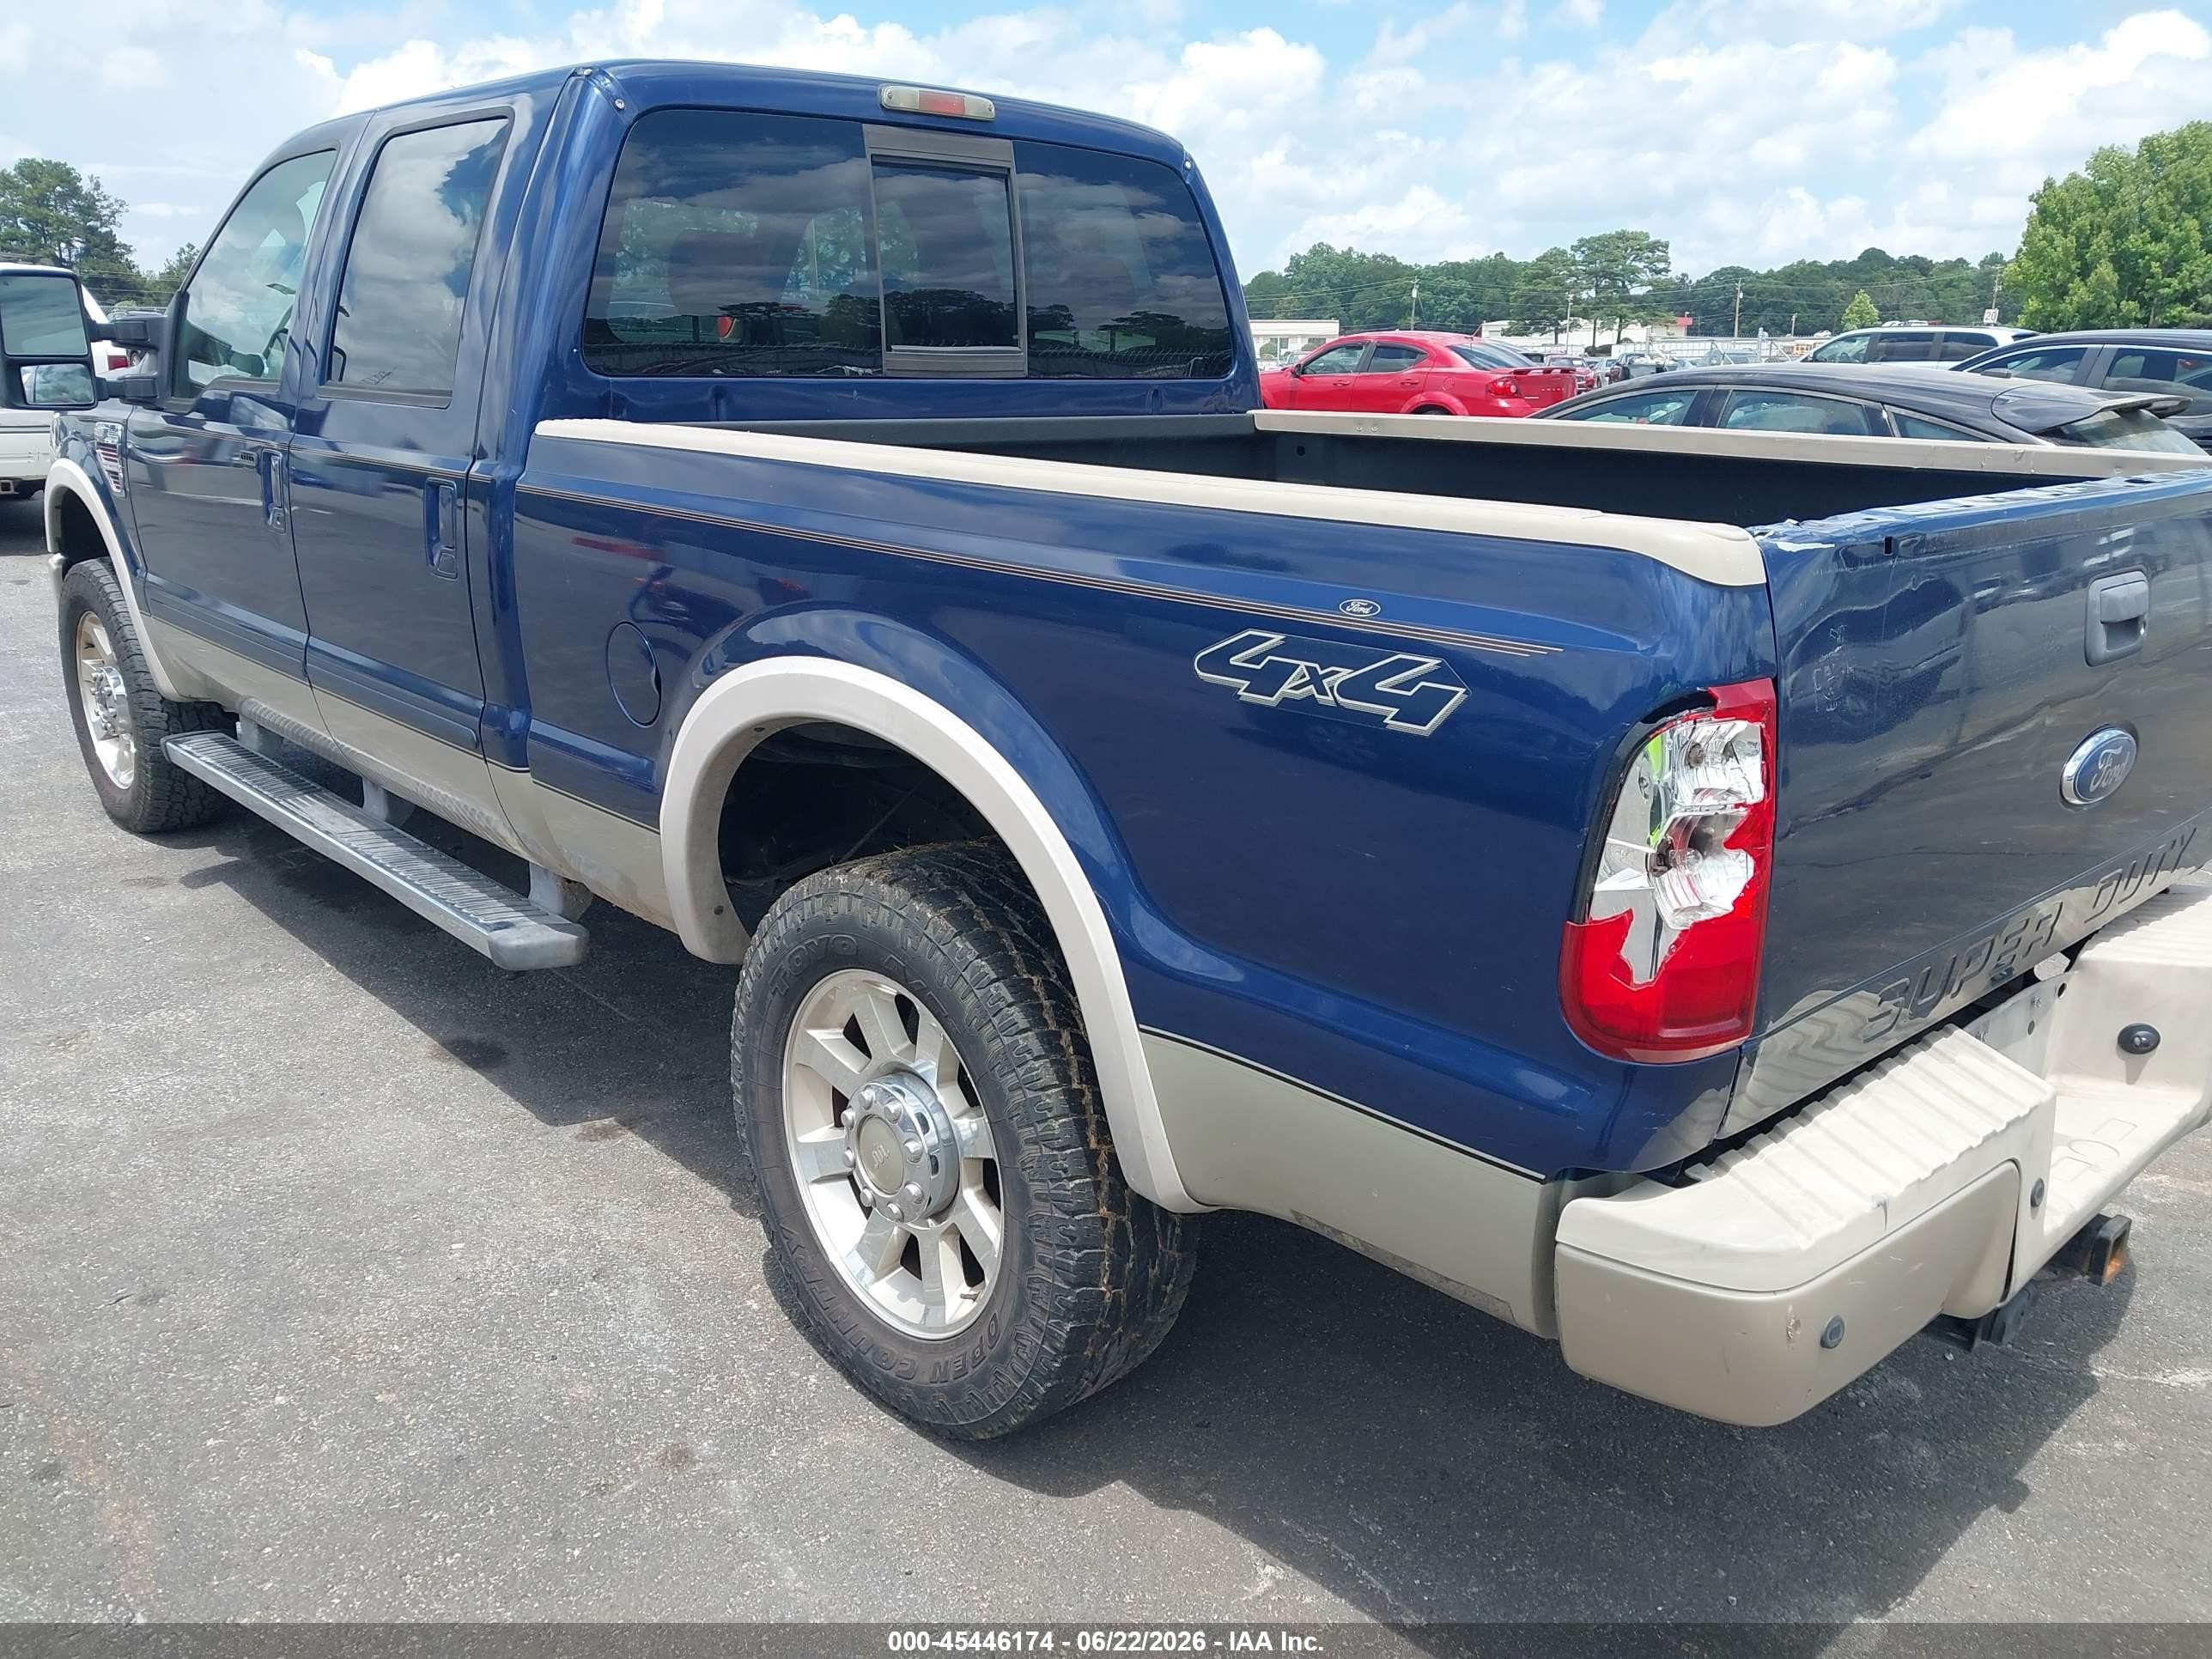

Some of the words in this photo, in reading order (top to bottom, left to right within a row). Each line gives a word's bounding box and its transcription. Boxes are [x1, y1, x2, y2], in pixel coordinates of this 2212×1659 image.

[1345, 601, 1374, 614] Ford
[769, 933, 860, 998] TOYO
[1862, 902, 2064, 1044] SUPER
[2084, 827, 2197, 924] DUTY
[779, 1223, 919, 1382] COUNTRY
[928, 1312, 1000, 1385] OPEN
